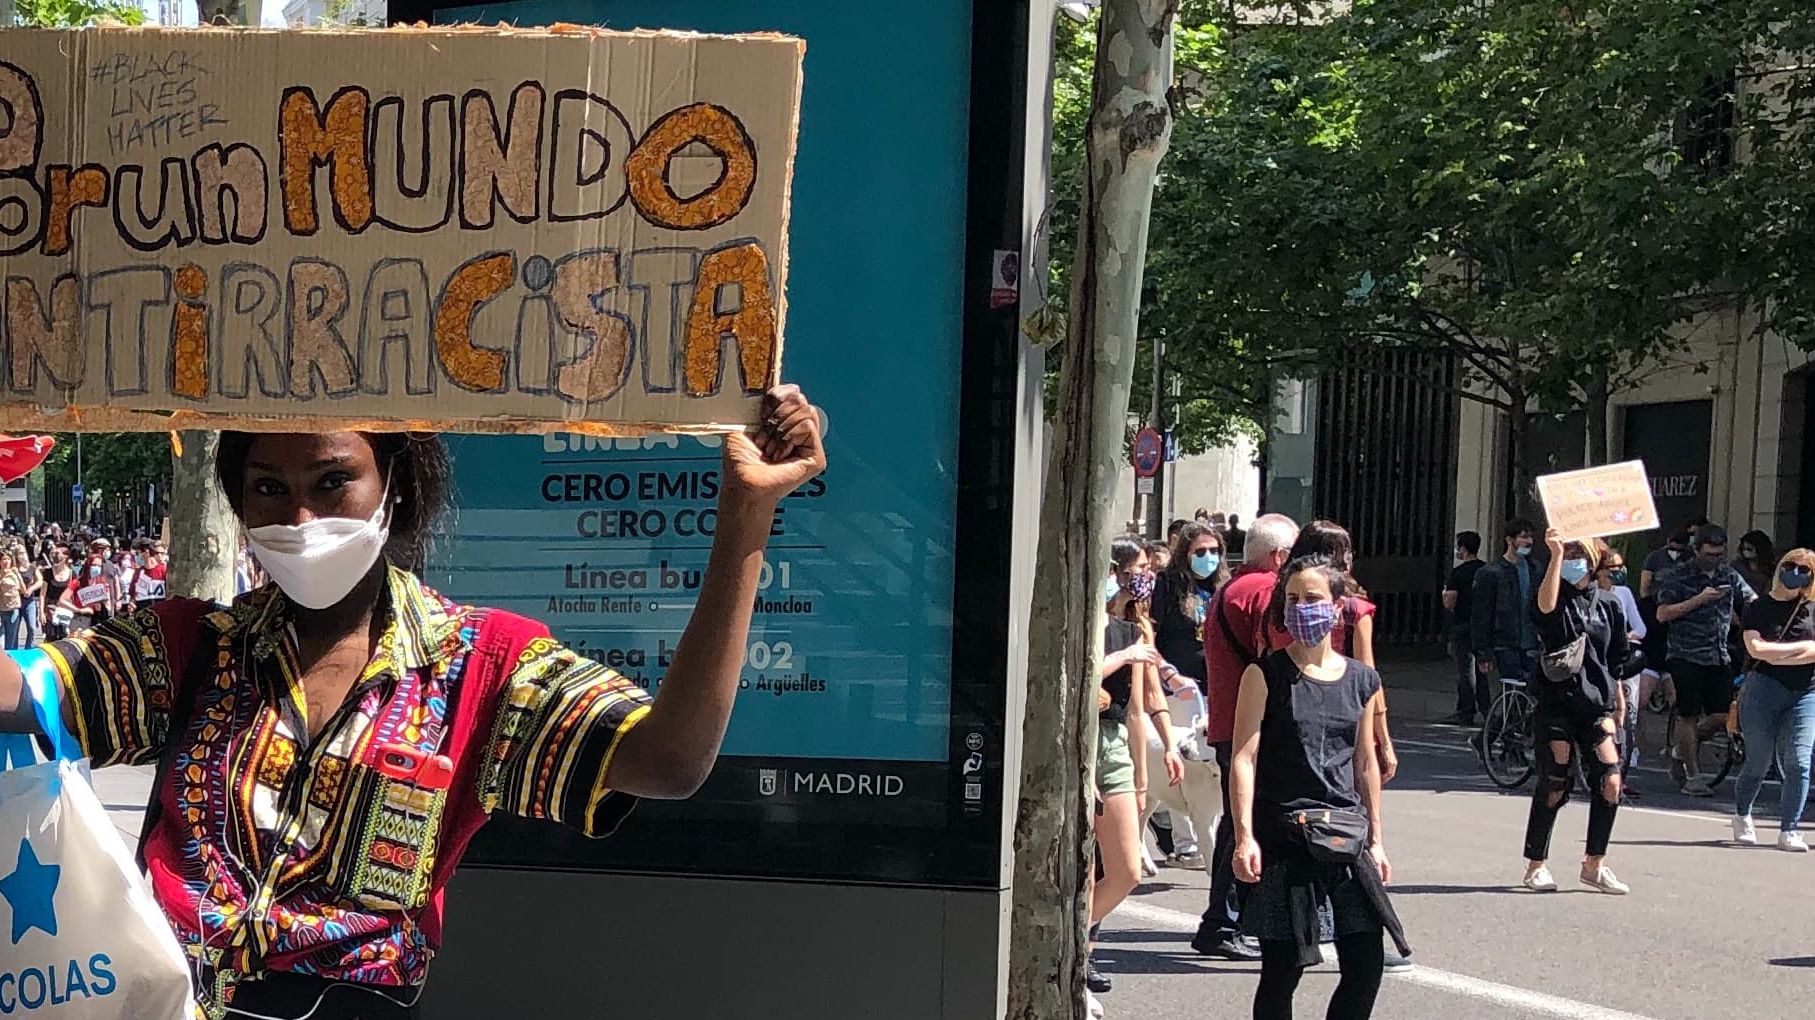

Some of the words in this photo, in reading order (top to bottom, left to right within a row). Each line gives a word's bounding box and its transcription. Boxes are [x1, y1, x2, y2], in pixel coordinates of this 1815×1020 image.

[89, 50, 213, 84] #BLACK
[110, 78, 197, 117] LIVES
[278, 80, 758, 236] MUNDO
[541, 473, 630, 502] CERO
[638, 471, 826, 500] EMISS
[1649, 475, 1698, 496] UAREZ
[577, 509, 666, 538] CERO
[674, 508, 785, 536] COE
[565, 562, 647, 590] Línea
[660, 560, 706, 590] bu
[757, 561, 790, 590] 01
[547, 595, 596, 614] Atocha
[601, 594, 642, 614] Renfe
[753, 595, 812, 614] Moncloa
[564, 640, 646, 668] ínea
[742, 641, 793, 670] 02
[756, 673, 826, 697] Argüelles
[794, 772, 904, 796] MADRID
